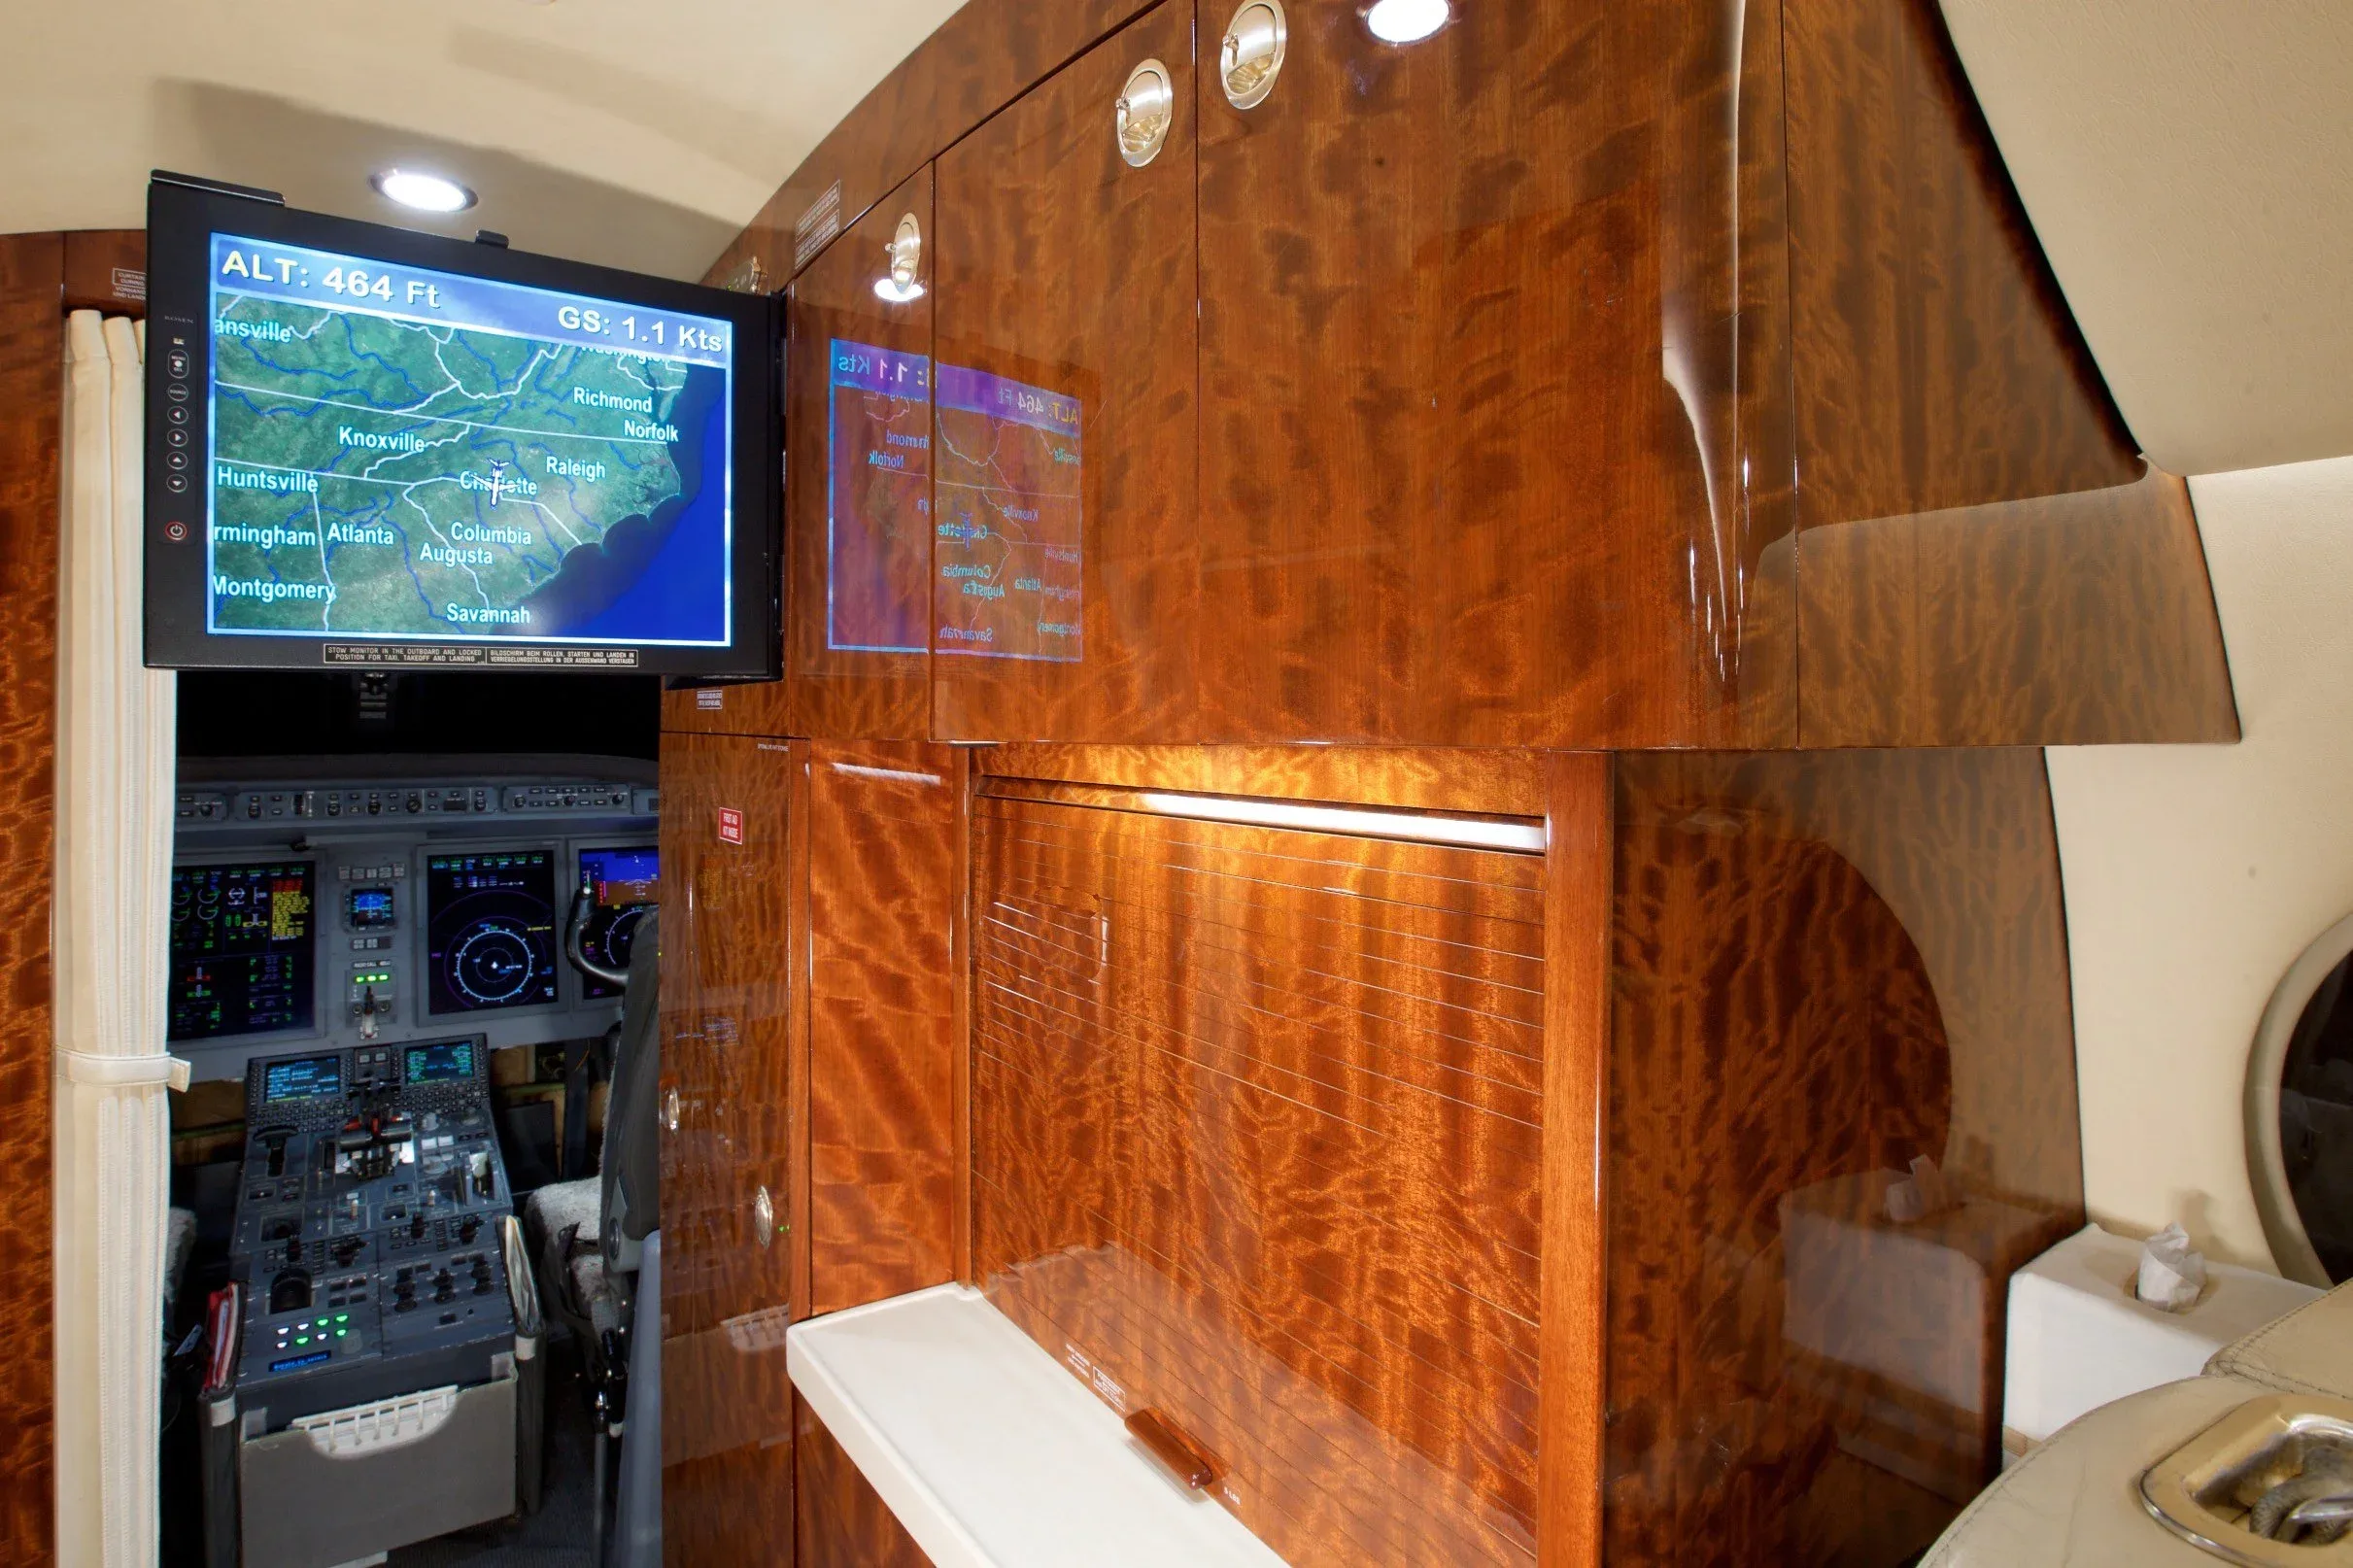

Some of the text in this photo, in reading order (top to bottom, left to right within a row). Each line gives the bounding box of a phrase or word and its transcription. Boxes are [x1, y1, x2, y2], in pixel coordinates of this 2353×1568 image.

[222, 250, 441, 309] ALT: 464 Ft
[215, 318, 291, 343] ansville
[558, 306, 723, 353] GS: 1.1 Kts
[573, 387, 653, 413] Richmond
[339, 426, 426, 452] Knoxville
[624, 419, 679, 442] Norfolk
[218, 465, 319, 493] Huntsville
[546, 457, 606, 482] Raleigh
[215, 523, 316, 549] rmingham
[327, 523, 394, 545] Atlanta
[451, 522, 531, 544] Columbia
[420, 543, 493, 567] Augusta
[214, 575, 335, 604] Montgomery
[447, 602, 530, 624] Savannah
